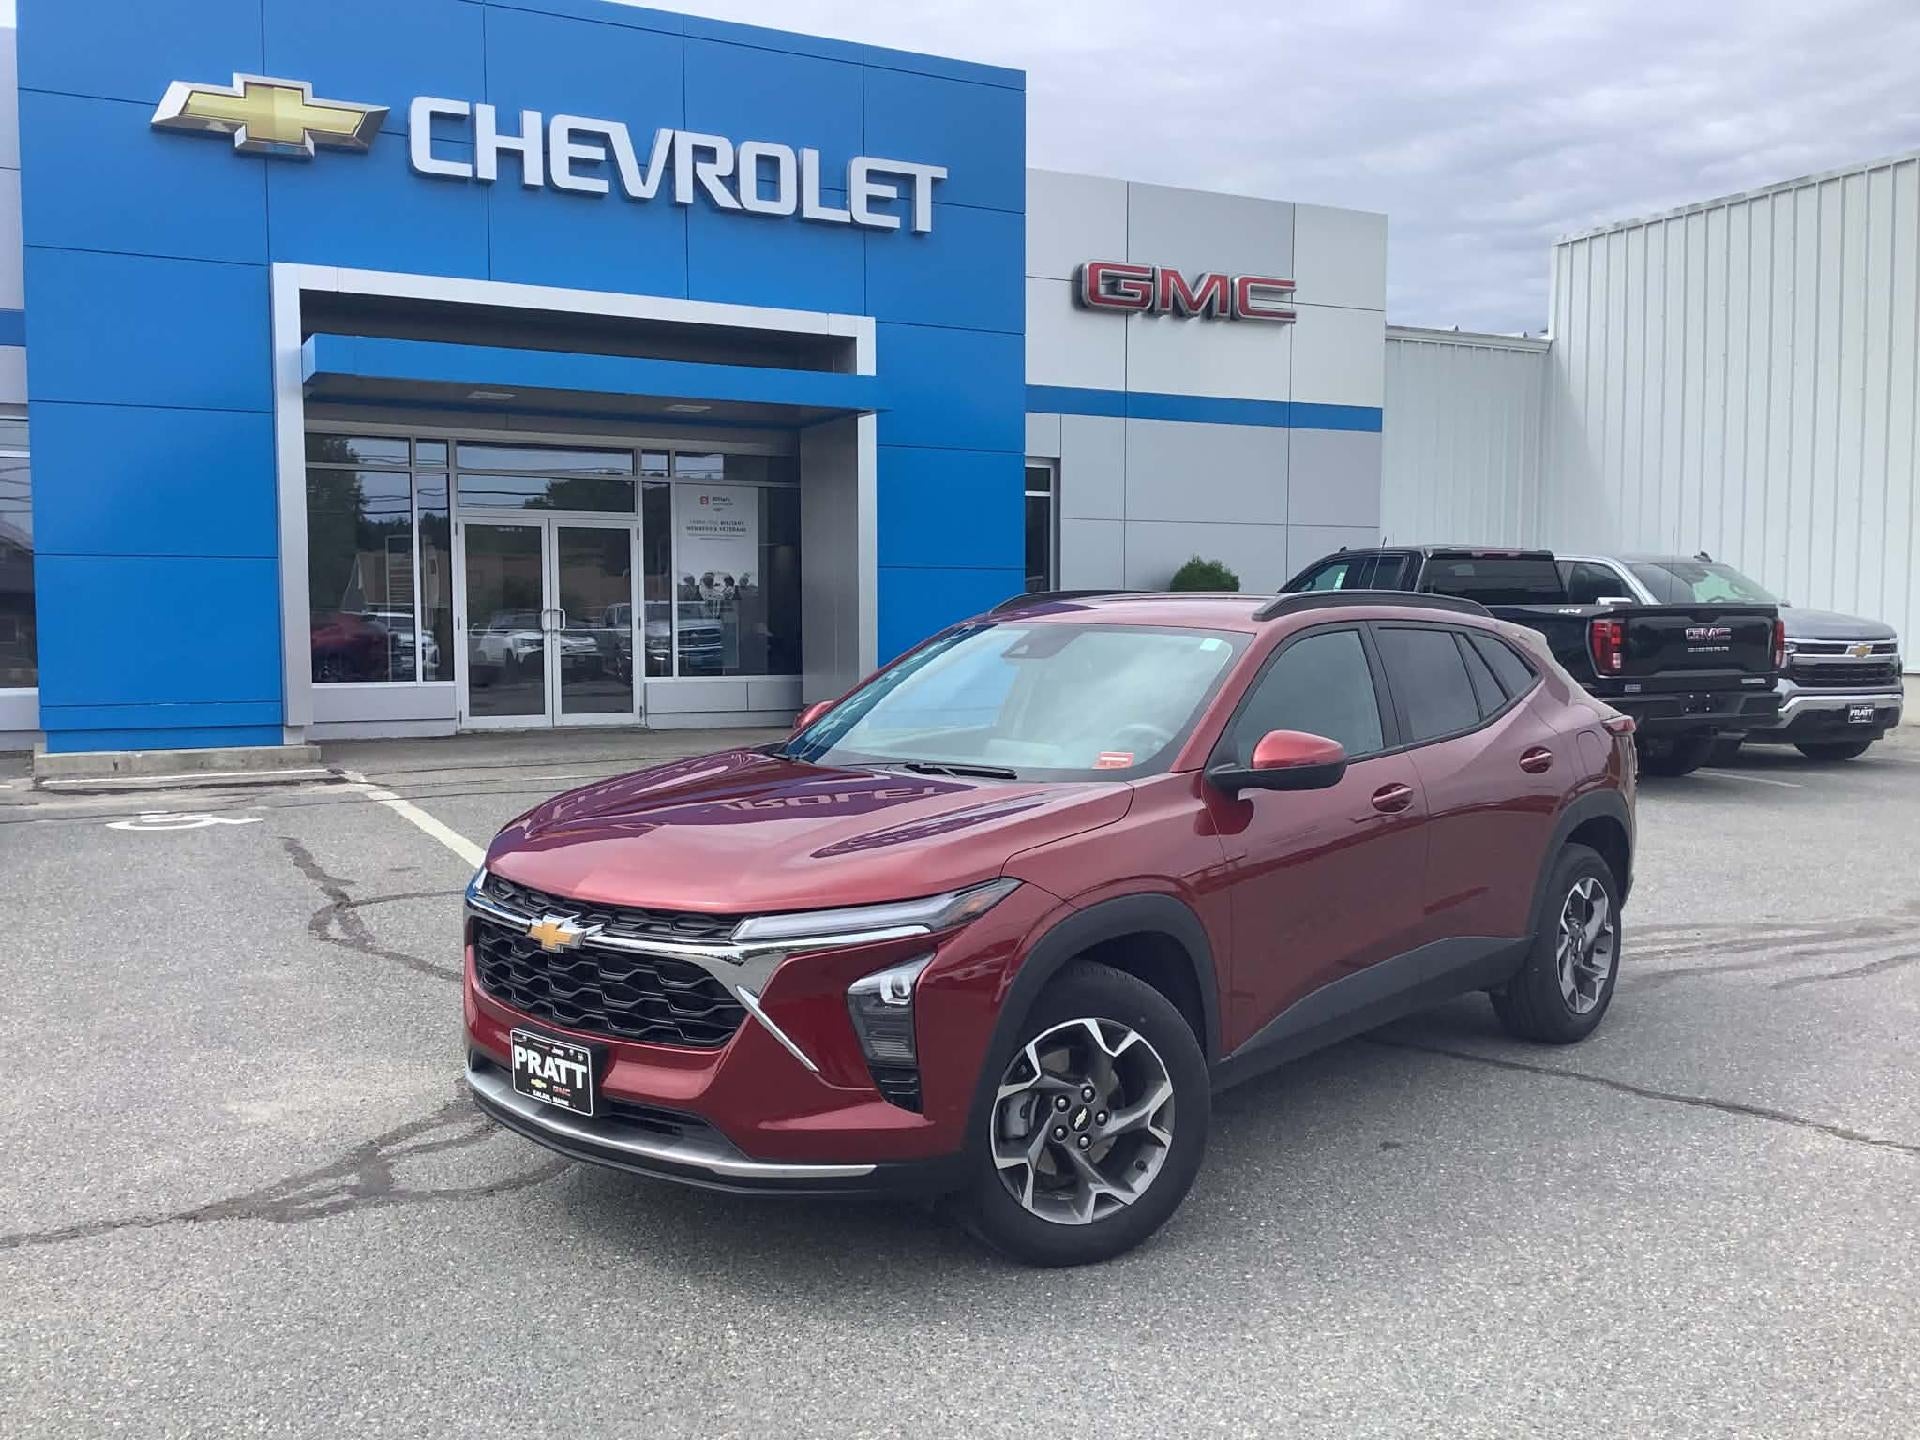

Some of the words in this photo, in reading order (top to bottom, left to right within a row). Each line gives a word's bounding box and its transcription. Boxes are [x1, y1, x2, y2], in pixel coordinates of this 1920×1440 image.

[409, 96, 948, 234] CHEVROLET
[1074, 260, 1297, 324] GMC
[1685, 627, 1732, 640] GMC
[1850, 708, 1875, 717] PRATT
[514, 1044, 588, 1089] PRATT
